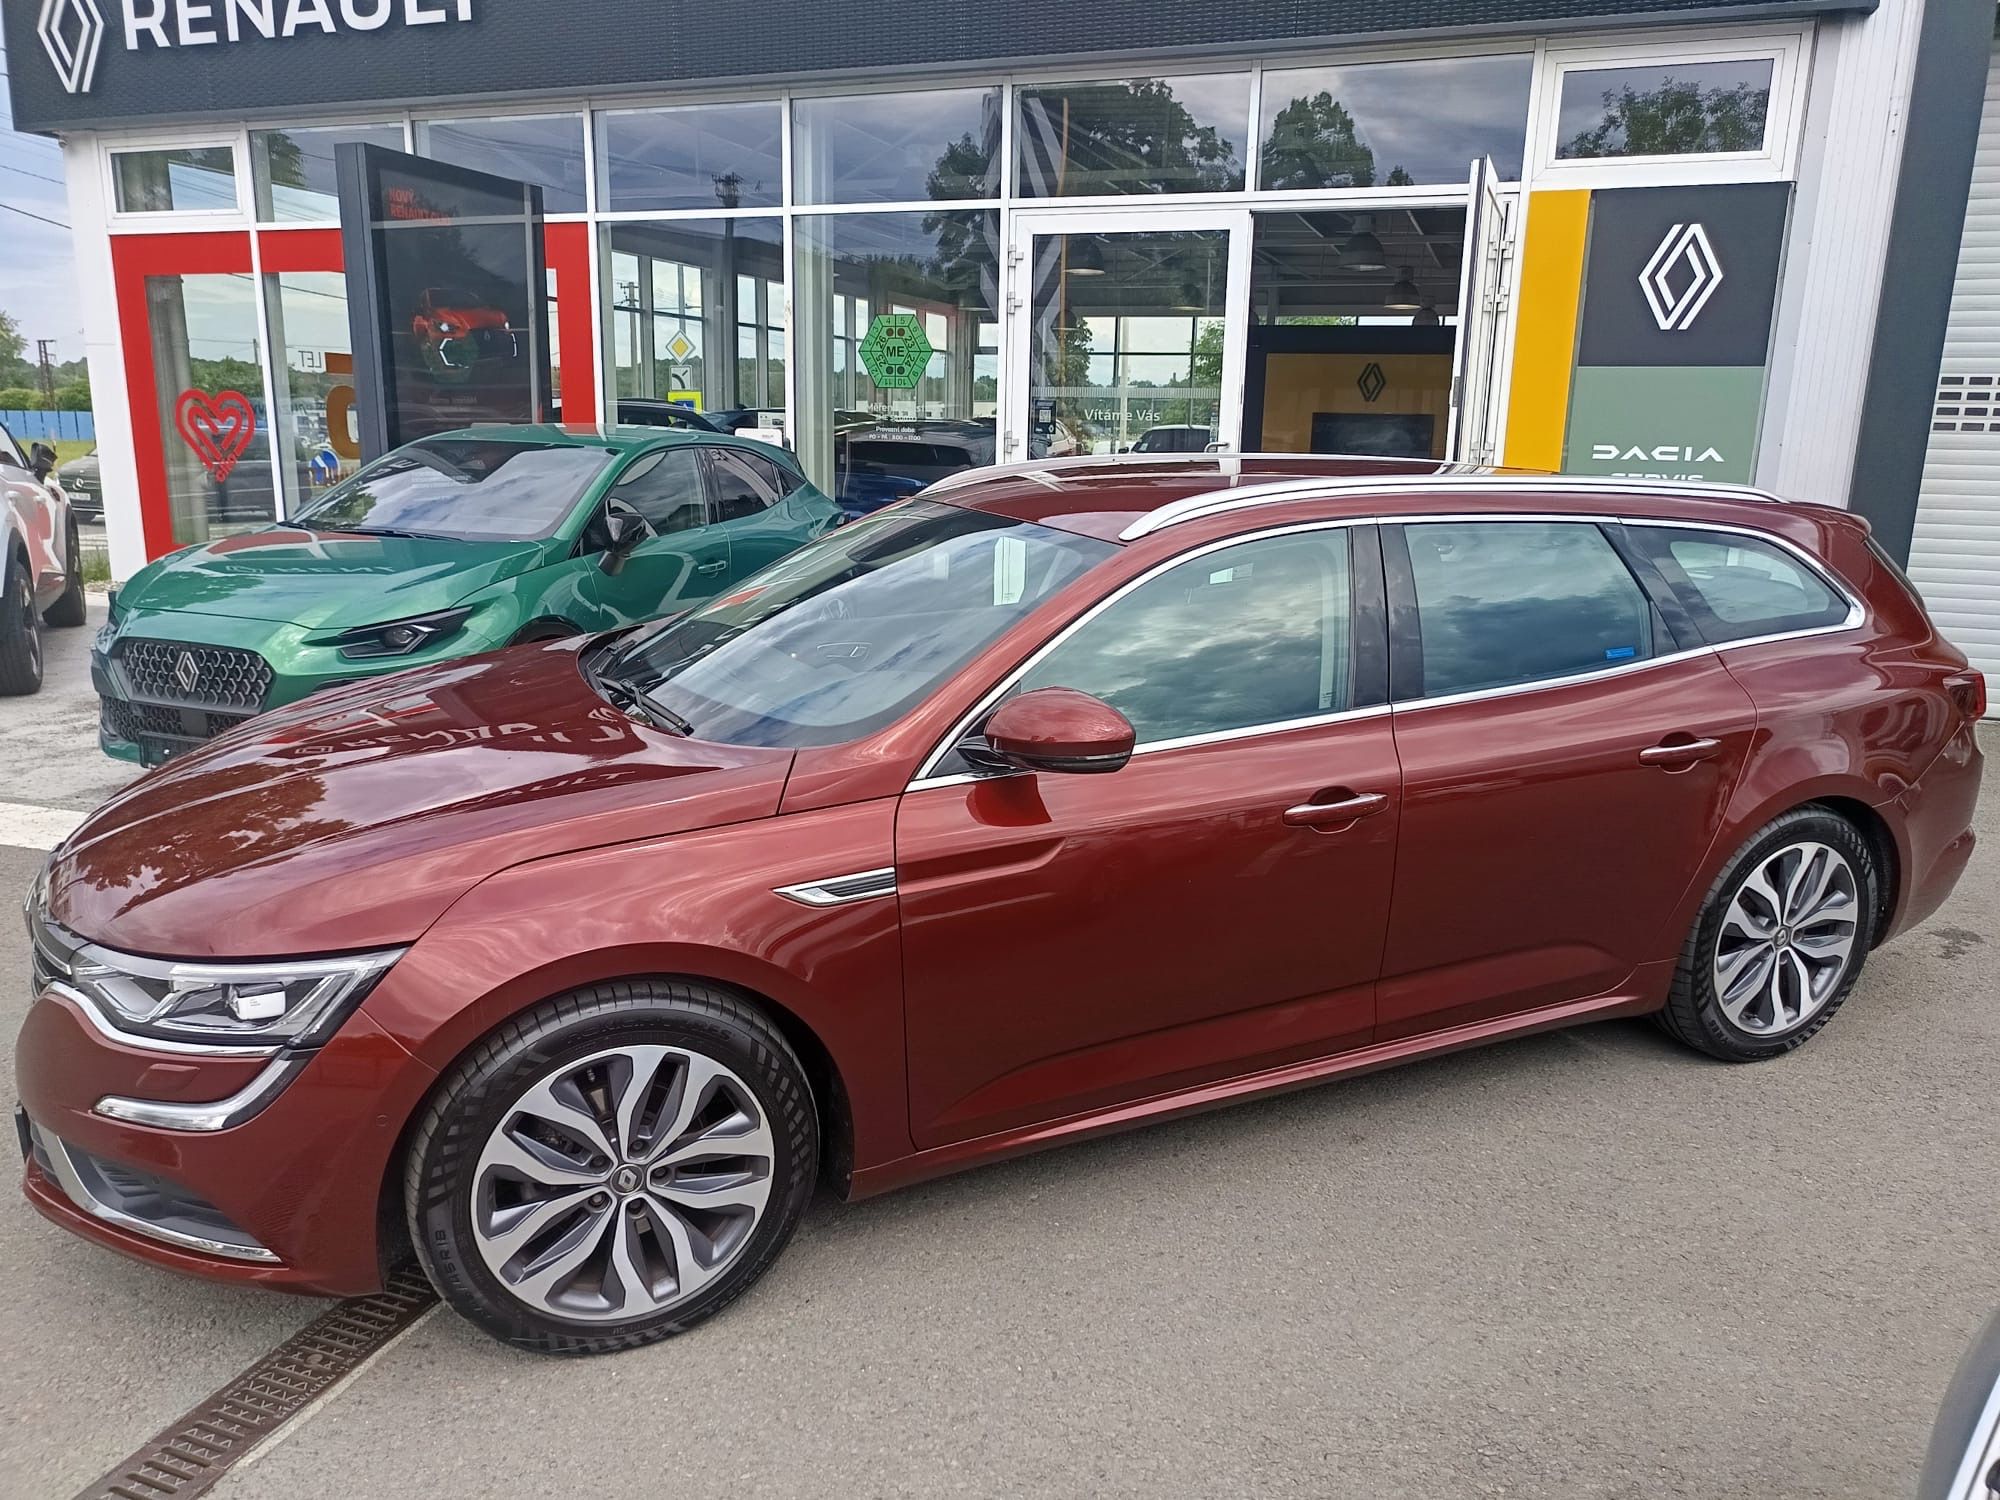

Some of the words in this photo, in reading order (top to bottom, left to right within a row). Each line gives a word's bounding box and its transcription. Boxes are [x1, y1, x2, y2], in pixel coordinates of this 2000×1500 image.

[886, 346, 905, 358] ME
[1084, 408, 1133, 421] Vítáme
[1136, 408, 1161, 422] Vás
[1592, 444, 1725, 462] DACIA
